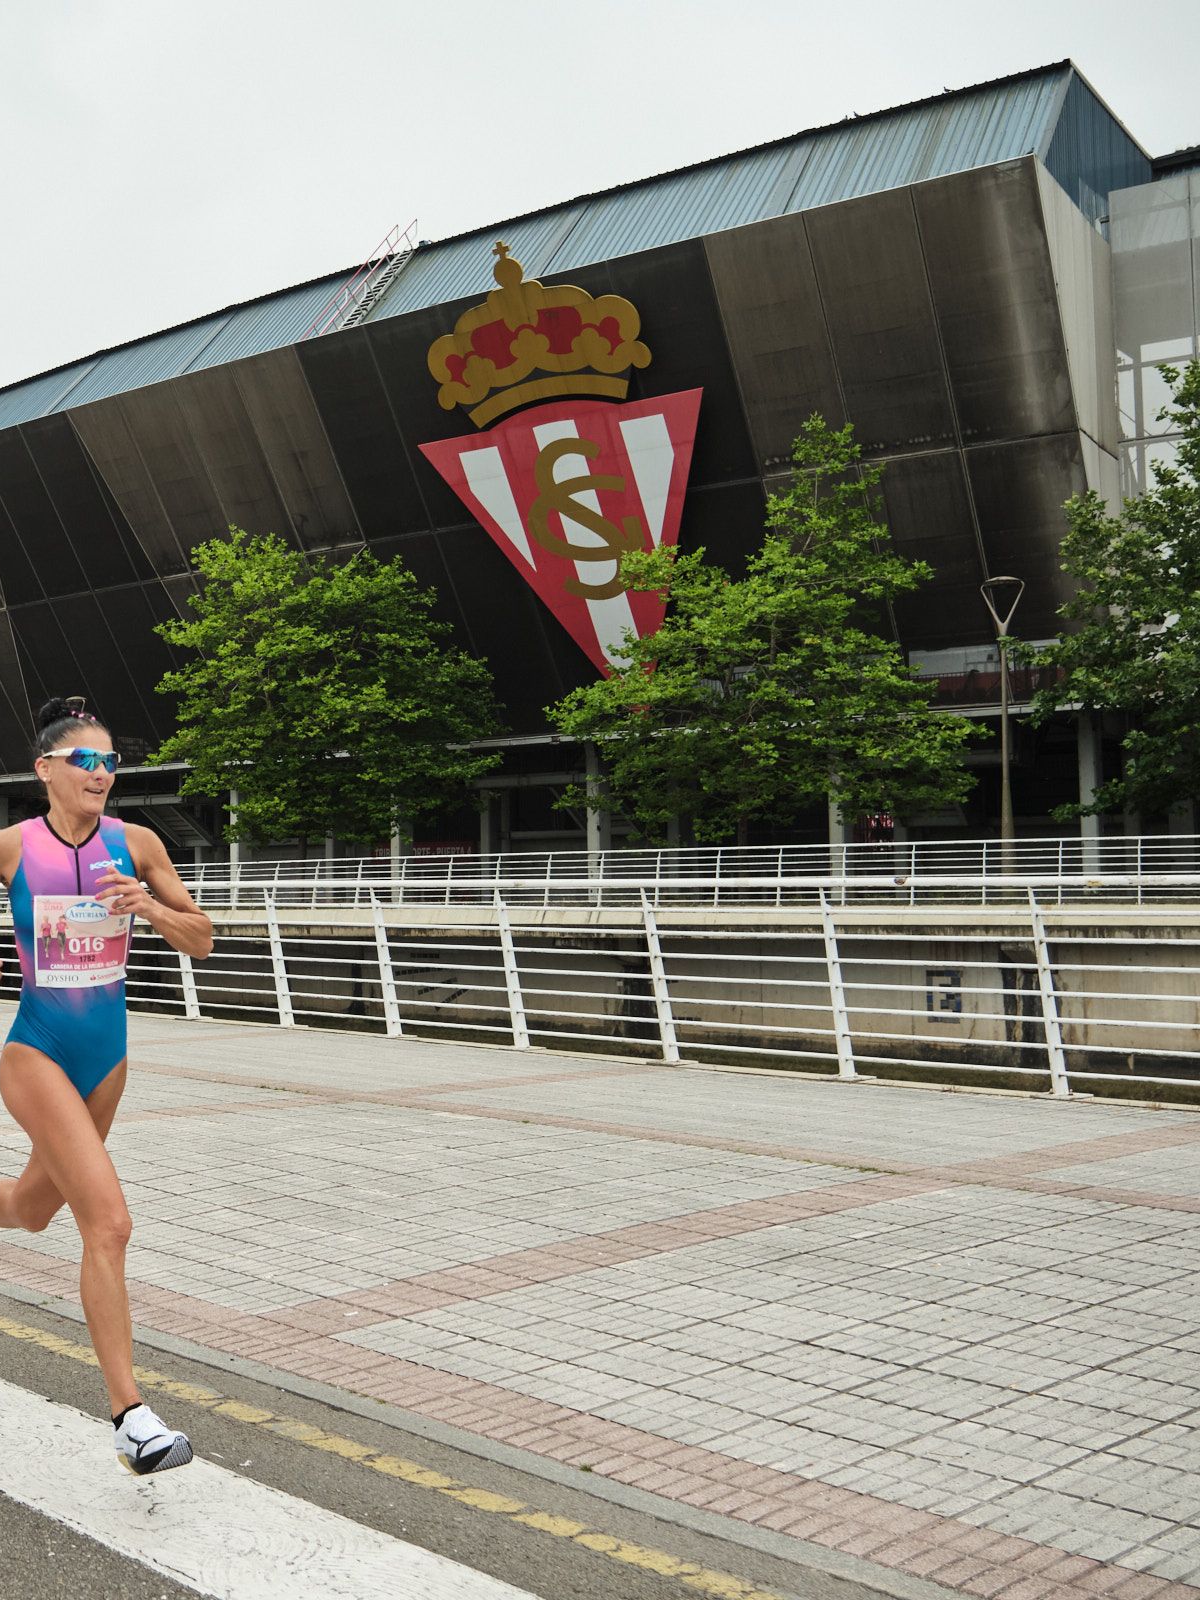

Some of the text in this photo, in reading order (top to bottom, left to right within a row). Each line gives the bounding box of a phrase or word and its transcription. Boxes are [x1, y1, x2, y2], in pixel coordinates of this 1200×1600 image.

[69, 909, 107, 919] ASTURIANA
[68, 936, 105, 954] 016
[47, 974, 79, 982] OYSHO
